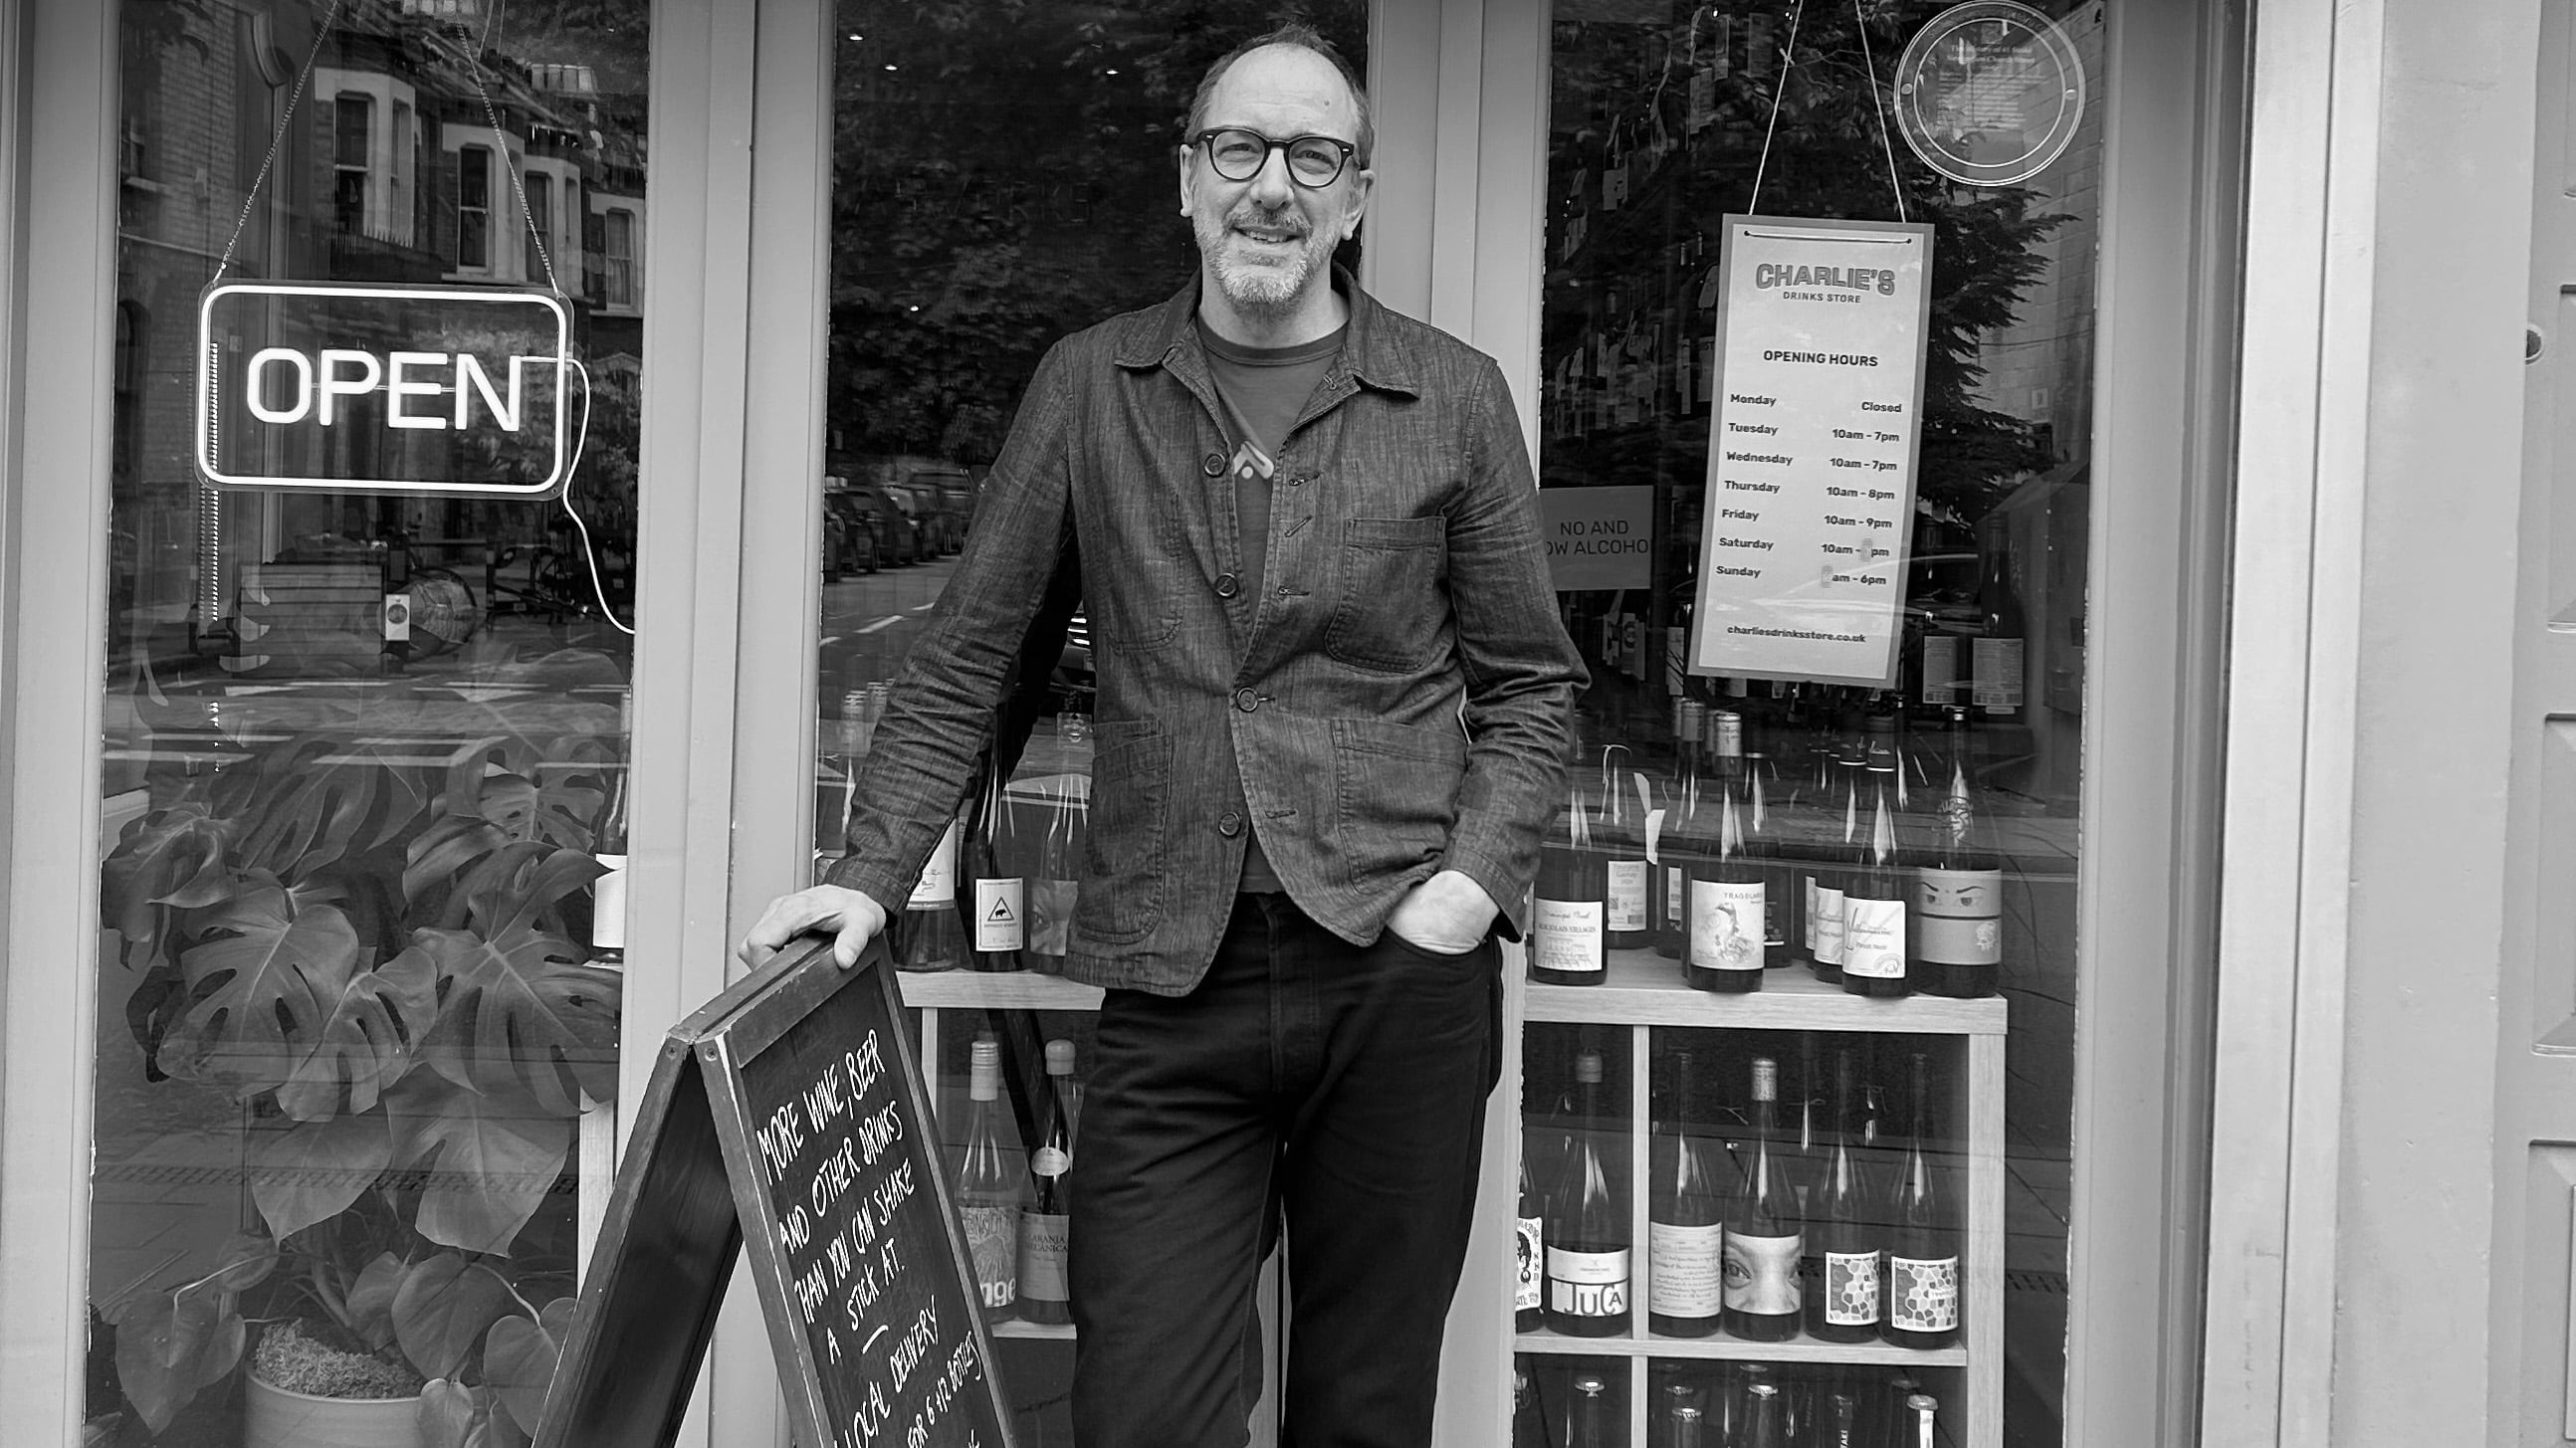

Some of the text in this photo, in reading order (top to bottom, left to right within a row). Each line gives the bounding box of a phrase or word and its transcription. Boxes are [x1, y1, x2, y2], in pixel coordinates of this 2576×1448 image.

[1756, 263, 1895, 296] CHARLIE'S
[1783, 292, 1861, 303] DRINKS STORE
[1763, 350, 1879, 367] OPENING HOURS
[247, 347, 522, 432] OPEN
[1730, 393, 1902, 413] Monday Closed
[1728, 422, 1779, 436] Tuesday
[1832, 428, 1863, 440] 10am
[1874, 431, 1899, 443] 7pm
[1726, 451, 1793, 466] Wednesday
[1829, 458, 1861, 468] 10am
[1872, 460, 1897, 472] 7pm
[1724, 480, 1780, 494] Thursday
[1826, 487, 1858, 497] 10am
[1868, 489, 1895, 501] 8pm
[1560, 519, 1629, 535] NO AND
[1721, 509, 1760, 522] Friday
[1825, 515, 1855, 525] 10am
[1866, 517, 1892, 529] 9pm
[1546, 538, 1649, 555] OW ALCOHO
[1719, 537, 1774, 551] Saturday
[1822, 543, 1852, 554] 10am
[1716, 565, 1762, 578] Sunday
[1860, 574, 1886, 585] 6pm
[1727, 626, 1866, 643] charliesdrinksstore.co.uk
[756, 1102, 803, 1186] MORE
[846, 1029, 886, 1101] BEER
[778, 1100, 903, 1255] AND OTHER DRINKS
[794, 1157, 915, 1325] HAN YOU CAN SHAKE
[827, 1327, 842, 1365] A
[847, 1264, 880, 1332] STICK
[890, 1295, 939, 1393] DELIVERY
[926, 1395, 936, 1425] 6
